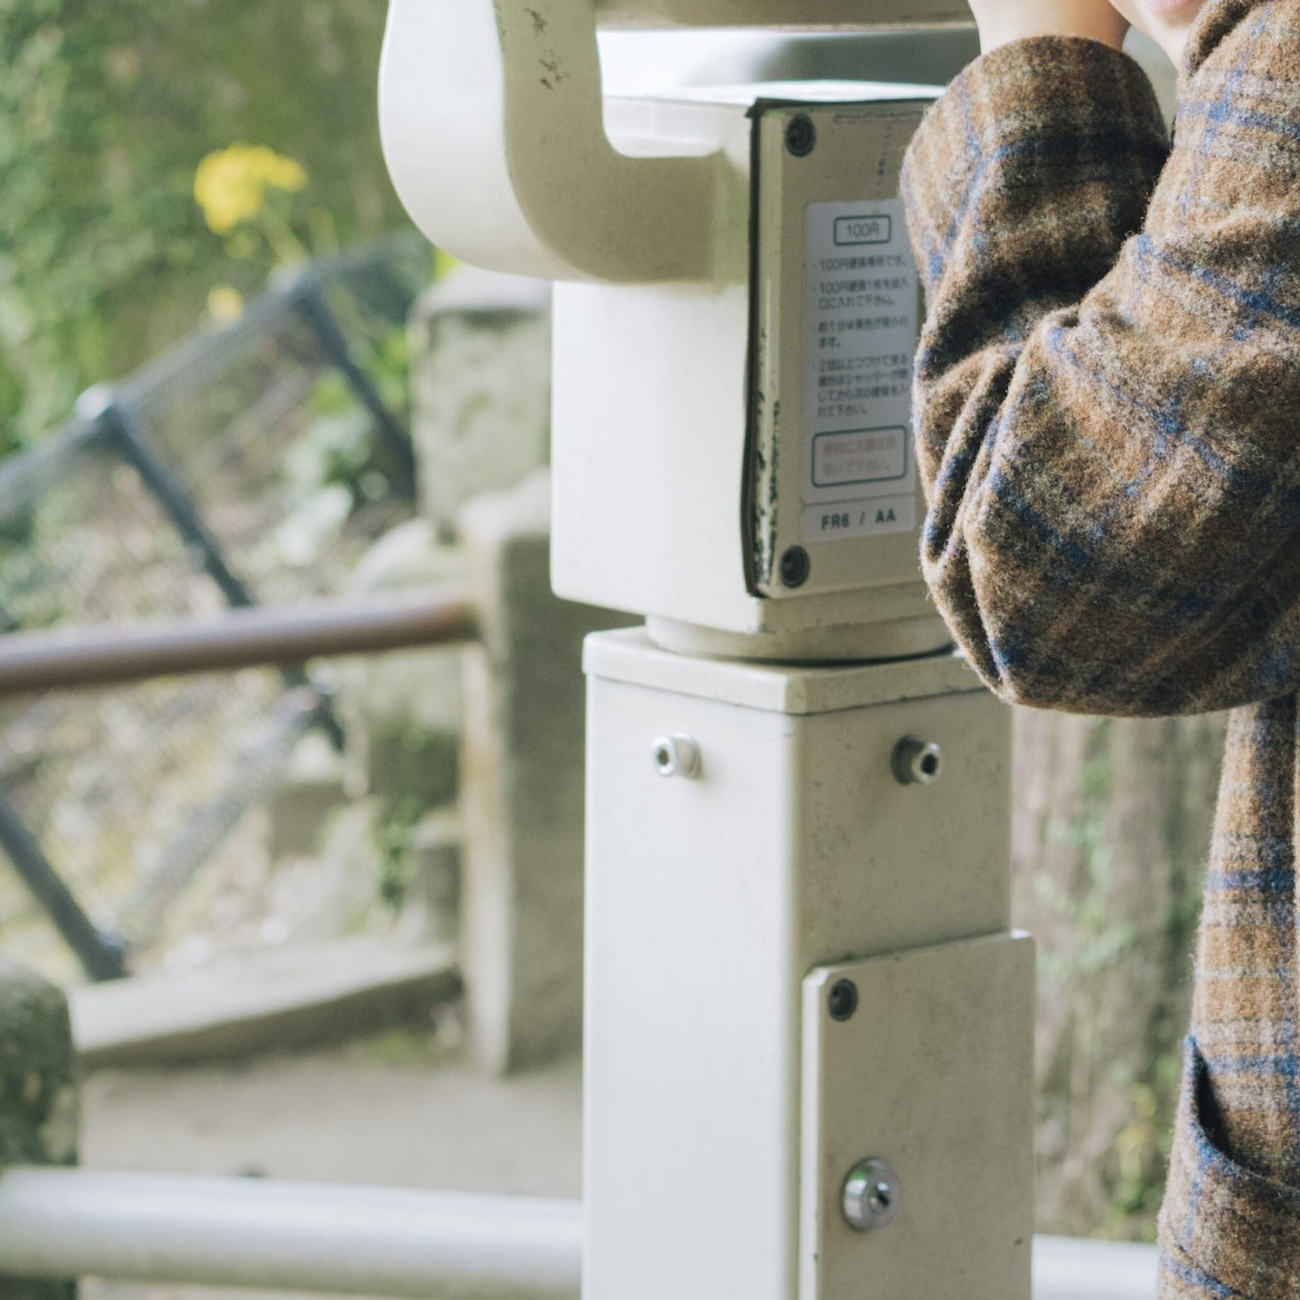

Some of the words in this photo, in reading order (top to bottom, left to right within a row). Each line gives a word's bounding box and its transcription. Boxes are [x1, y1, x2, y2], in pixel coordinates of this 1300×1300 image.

[846, 221, 880, 237] 100円
[821, 513, 850, 530] FR6
[875, 508, 896, 523] AA
